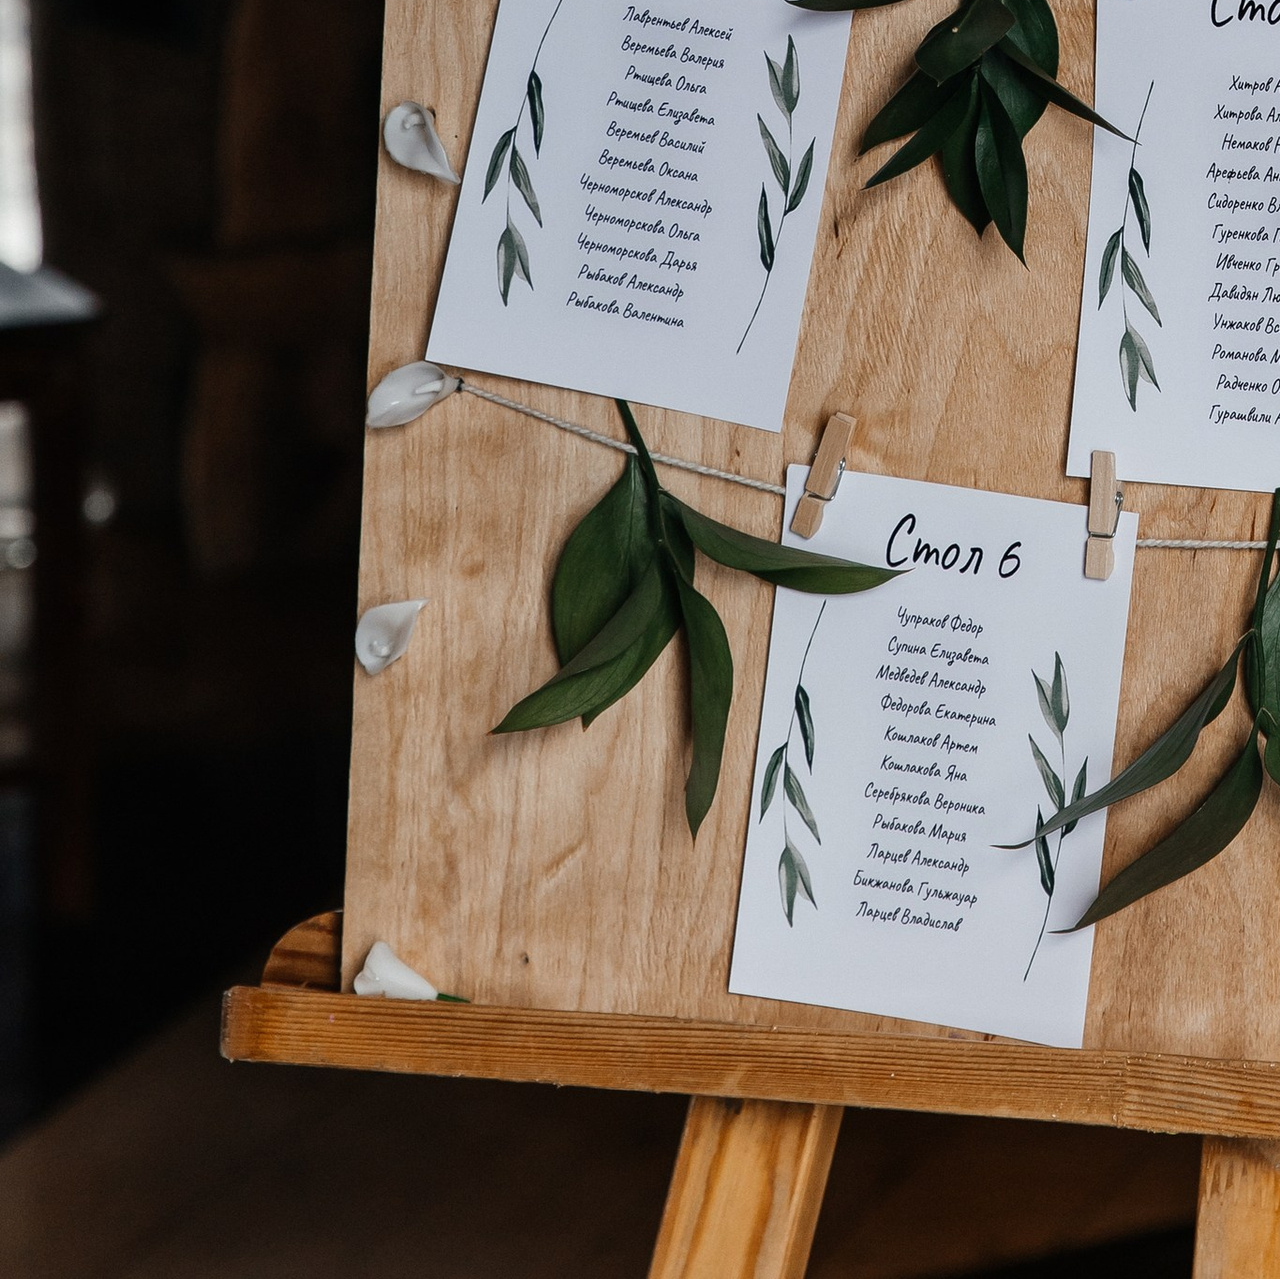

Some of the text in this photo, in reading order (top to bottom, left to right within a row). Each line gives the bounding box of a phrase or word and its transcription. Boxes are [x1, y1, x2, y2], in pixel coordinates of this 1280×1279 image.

[622, 6, 734, 41] Лаврентьев Алексей
[621, 35, 725, 71] Веремьева Валерия
[624, 65, 707, 94] Ртищева Ольга
[1228, 75, 1274, 96] Хитров
[606, 91, 715, 126] Ртищева Елизавета
[1213, 104, 1263, 125] Хитрова
[606, 120, 707, 154] Веремьев Василий
[1221, 133, 1274, 152] Немаков
[598, 149, 698, 182] Веремьева Оксана
[580, 173, 712, 219] Черноморсков Александр
[1208, 192, 1264, 214] Сидоренко
[585, 204, 700, 242] Черноморскова Ольга
[1212, 223, 1269, 244] Гуренкова
[1216, 252, 1262, 271] Ивченко
[577, 264, 684, 303] Рыбаков Александр
[1207, 282, 1259, 302] Давидян
[566, 291, 684, 328] Рыбакова Валентина
[1213, 312, 1265, 332] Унжаков
[1211, 343, 1268, 362] Романова
[1216, 374, 1268, 392] Радченко
[1209, 404, 1272, 425] Гурашвили
[886, 513, 1022, 578] Стол 6
[897, 606, 983, 639] Чупраков Федор
[888, 635, 989, 667] Супина Елизавета
[875, 664, 986, 699] Медведев Александр
[881, 693, 996, 728] Федорова Екатерина
[884, 725, 978, 755] Кошлаков Артем
[880, 754, 967, 782] Кошлакова Яна
[864, 782, 985, 815] Серебрякова Вероника
[872, 813, 967, 845] Рыбакова Мария
[866, 842, 969, 877] Ларцев Александр
[855, 901, 963, 932] Ларцев Владислав
